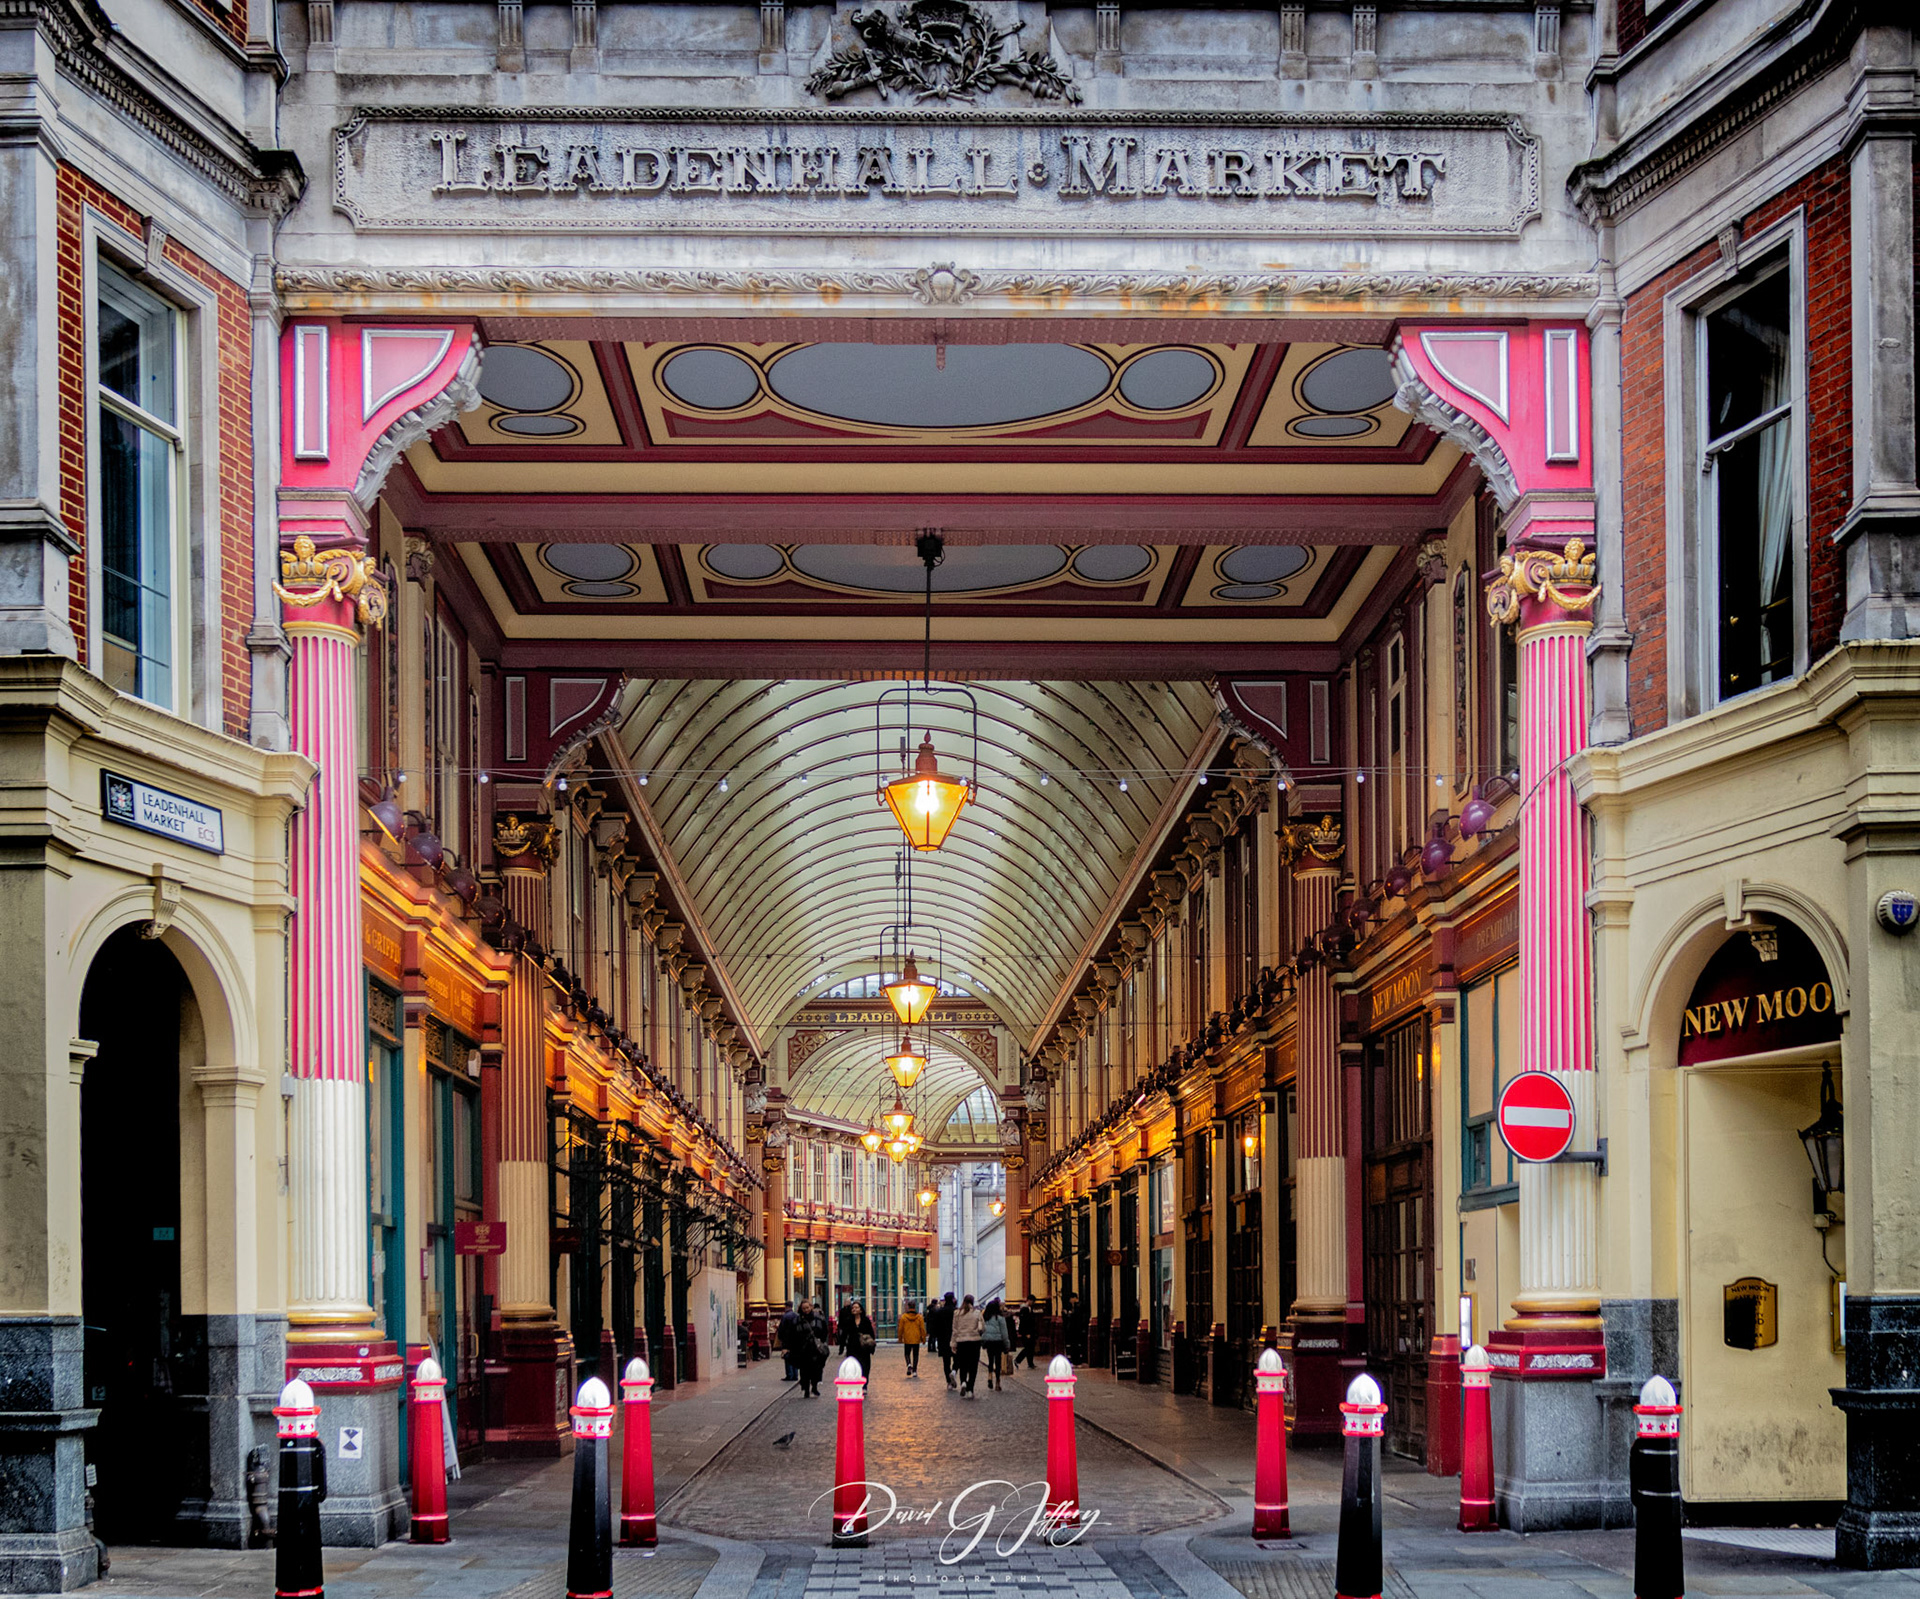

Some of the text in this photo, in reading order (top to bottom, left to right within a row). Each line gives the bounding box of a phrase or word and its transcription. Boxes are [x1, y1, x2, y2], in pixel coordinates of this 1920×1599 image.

[430, 129, 1447, 199] LEADENHALL MARKET
[142, 792, 206, 825] LEADENHALL
[143, 808, 215, 843] MARKET EC3
[1371, 966, 1422, 1019] NEW MOON
[1683, 981, 1833, 1037] NEW MOO
[834, 1012, 953, 1023] LEADEALL
